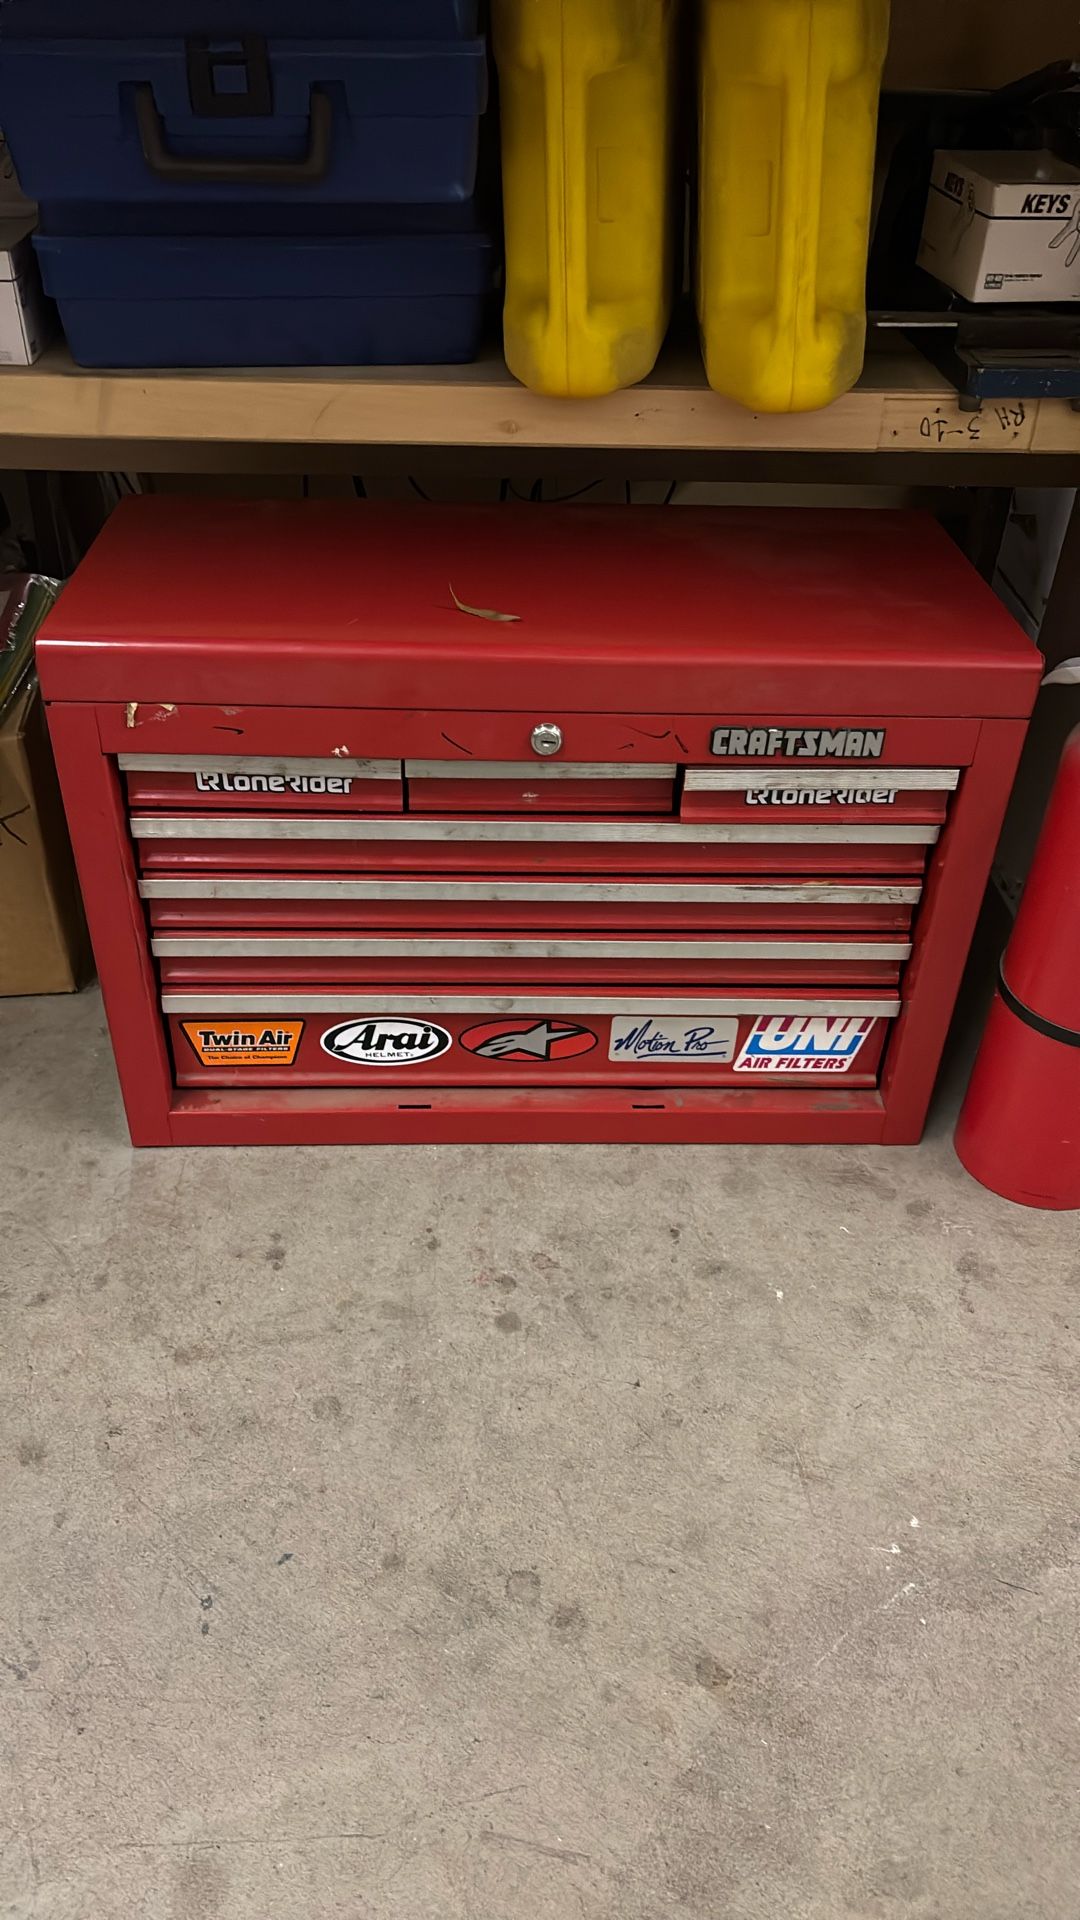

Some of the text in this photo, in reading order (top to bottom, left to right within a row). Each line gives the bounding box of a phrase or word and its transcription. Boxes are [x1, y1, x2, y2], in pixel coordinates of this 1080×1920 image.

[944, 172, 964, 197] KEYS
[1021, 193, 1071, 213] KEYS
[994, 402, 1025, 431] RH
[711, 728, 886, 757] CRAFTSMAN
[199, 1030, 293, 1046] Twin Air
[333, 1024, 435, 1051] Arai
[614, 1019, 729, 1054] Motion Pro
[758, 1016, 866, 1051] UNI
[738, 1057, 847, 1069] AIR FILTERS
